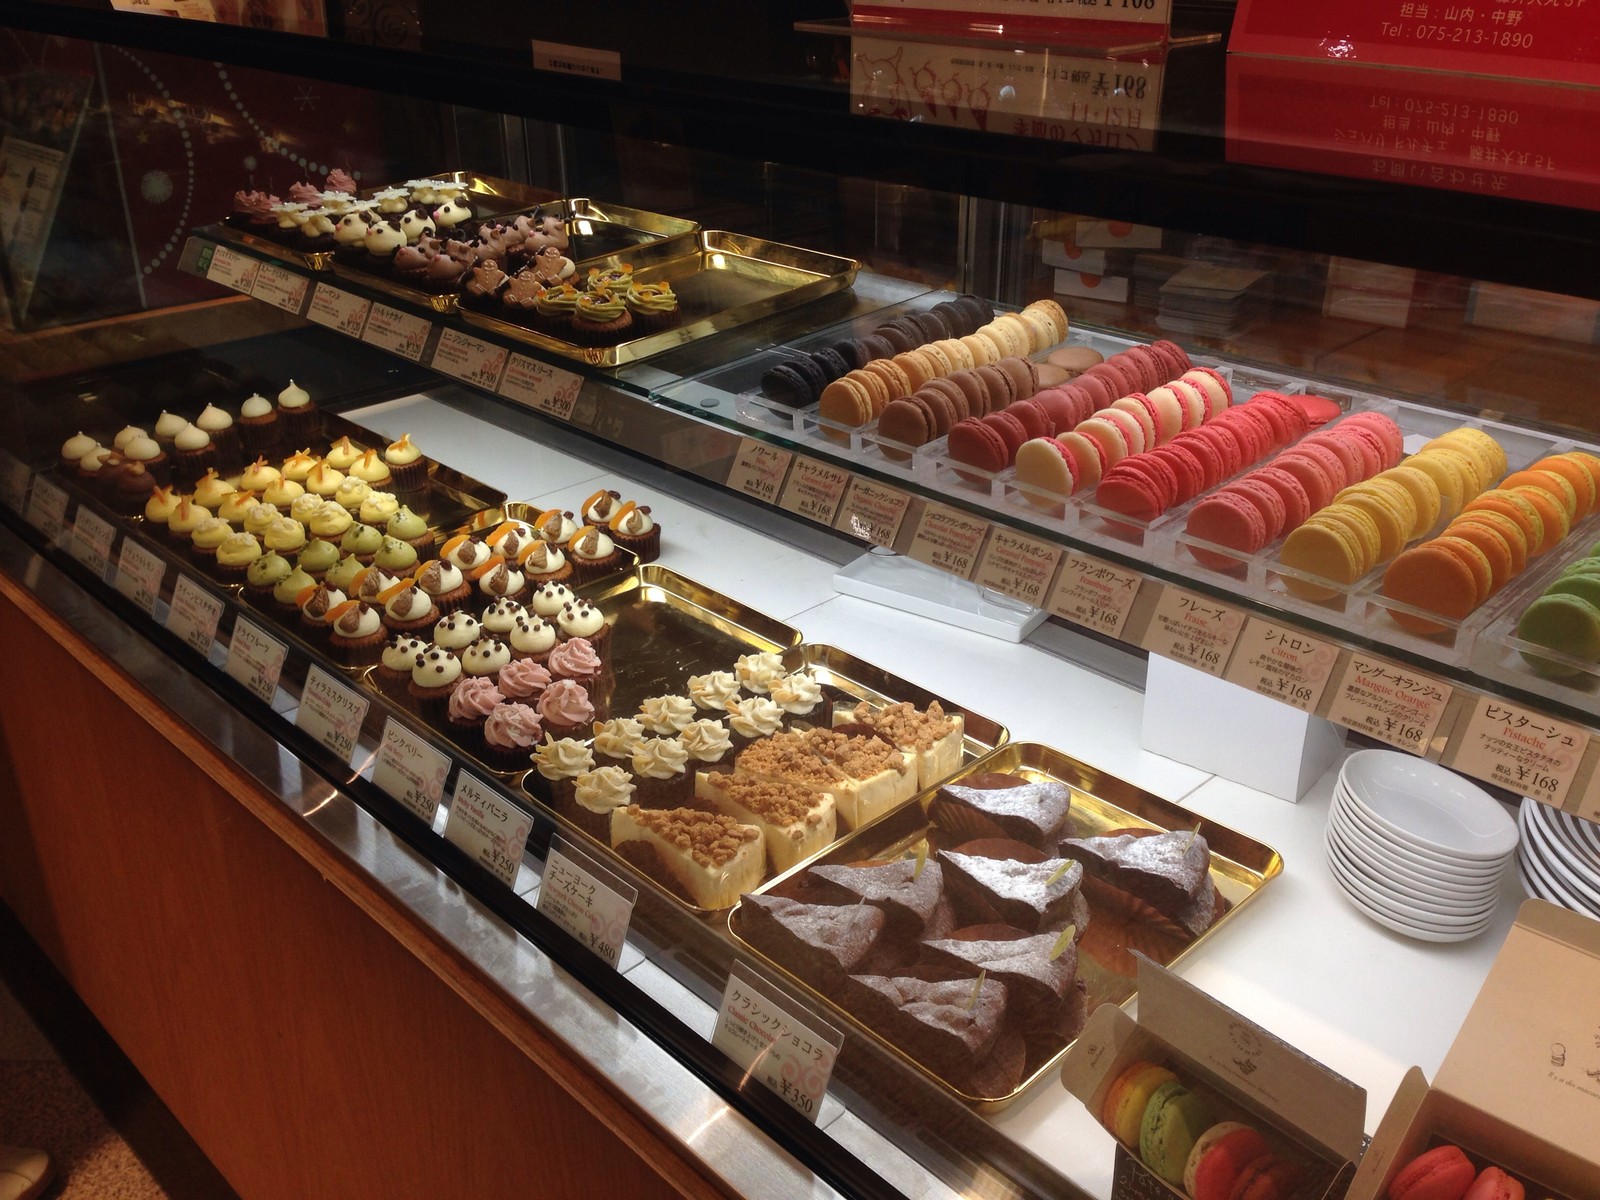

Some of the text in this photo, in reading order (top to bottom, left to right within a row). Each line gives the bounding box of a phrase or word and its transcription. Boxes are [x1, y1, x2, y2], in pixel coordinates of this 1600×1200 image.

[1416, 25, 1534, 48] 075-213-1890
[750, 444, 779, 461] ノワール
[796, 459, 844, 485] キャラメルサレ
[753, 478, 775, 494] ¥168
[851, 482, 905, 508] オーガニックショコラ
[809, 499, 832, 516] ¥168
[942, 550, 969, 569] ¥168
[1011, 577, 1040, 596] ¥168
[1078, 574, 1114, 593] Framboise
[1086, 605, 1119, 626] ¥168
[1177, 595, 1225, 622] フレーズ
[1183, 612, 1208, 627] Fraise
[1185, 642, 1221, 665] ¥168
[1263, 627, 1316, 657] シトロン
[1270, 645, 1298, 662] Citron
[1248, 657, 1308, 685] レモン風味のマカロン
[1258, 653, 1303, 674] 爽やかな酸味の
[256, 674, 273, 695] ¥250
[1274, 677, 1313, 701] ¥168
[1350, 658, 1446, 701] マングーオランジュ
[1354, 674, 1432, 711] Mangue Orange
[309, 674, 360, 717] ティラミスクリスプ
[1346, 684, 1432, 721] 濃厚なアルフォンソマンゴーと
[1344, 692, 1427, 728] フレッシュオレンジのクリーム
[1381, 716, 1424, 743] ¥168
[1483, 704, 1578, 747] ピスターシュ
[1502, 726, 1547, 750] Pistache
[332, 730, 352, 752] ¥250
[387, 728, 424, 762] ピンクベリー
[1478, 731, 1561, 768] ナッツの女王ピスタチオの
[1483, 742, 1550, 774] ナッティーなクリーム
[1512, 764, 1560, 794] ¥168
[412, 789, 435, 814] ¥250
[490, 848, 515, 876] ¥250
[548, 867, 593, 910] チーズケーキ
[550, 856, 596, 898] ニューヨーク
[588, 931, 616, 963] ¥480
[727, 1003, 749, 1026] Classic
[730, 986, 824, 1065] クラシックショコラ
[778, 1076, 814, 1115] ¥350
